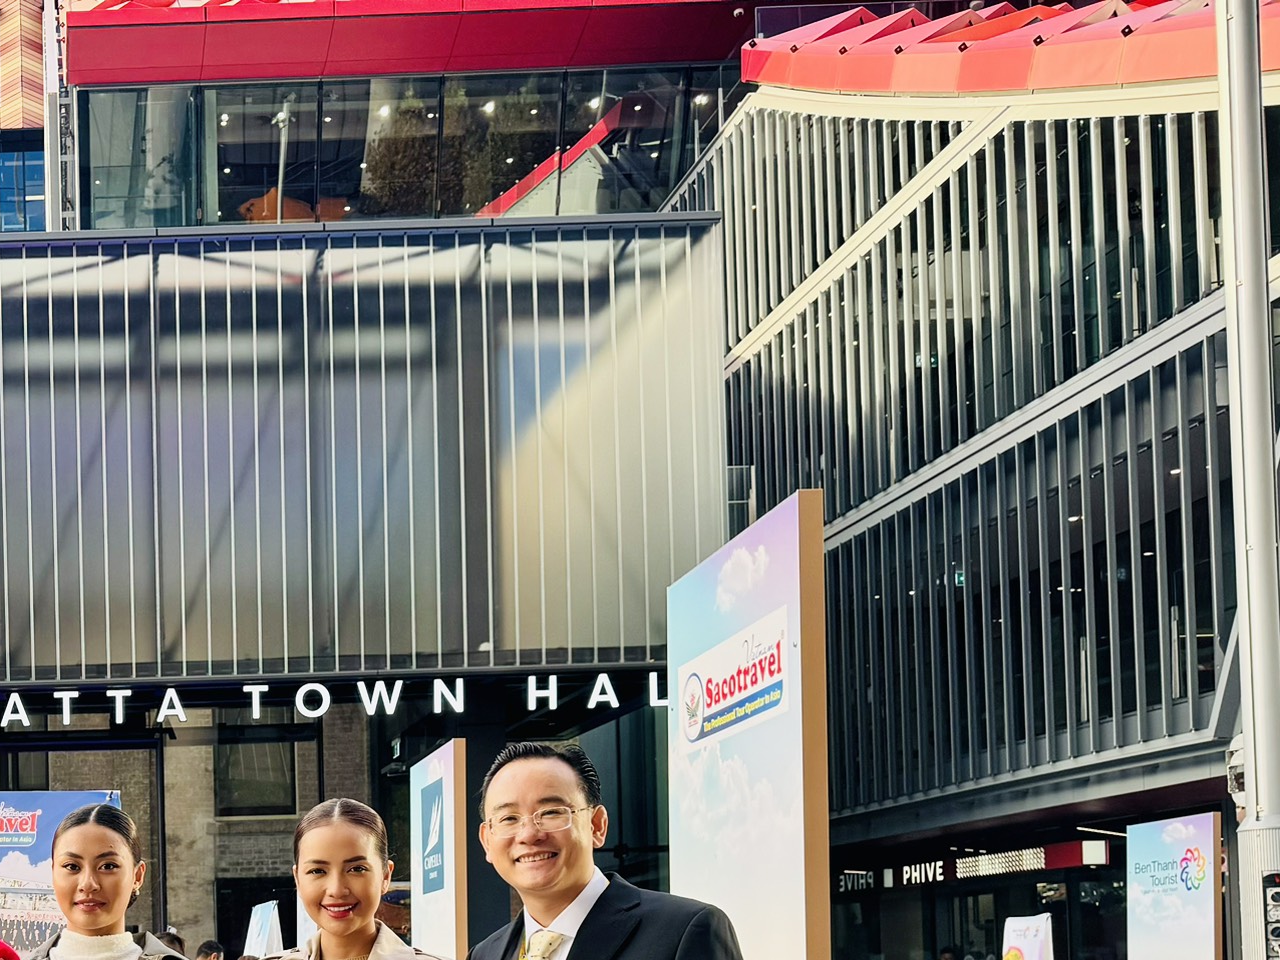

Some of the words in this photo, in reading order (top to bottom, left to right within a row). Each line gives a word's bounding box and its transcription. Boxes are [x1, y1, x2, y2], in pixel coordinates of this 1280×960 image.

[705, 639, 782, 709] Sacotravel
[243, 678, 465, 720] TOWN
[902, 860, 944, 885] PHIVE
[1150, 874, 1178, 887] Tourist
